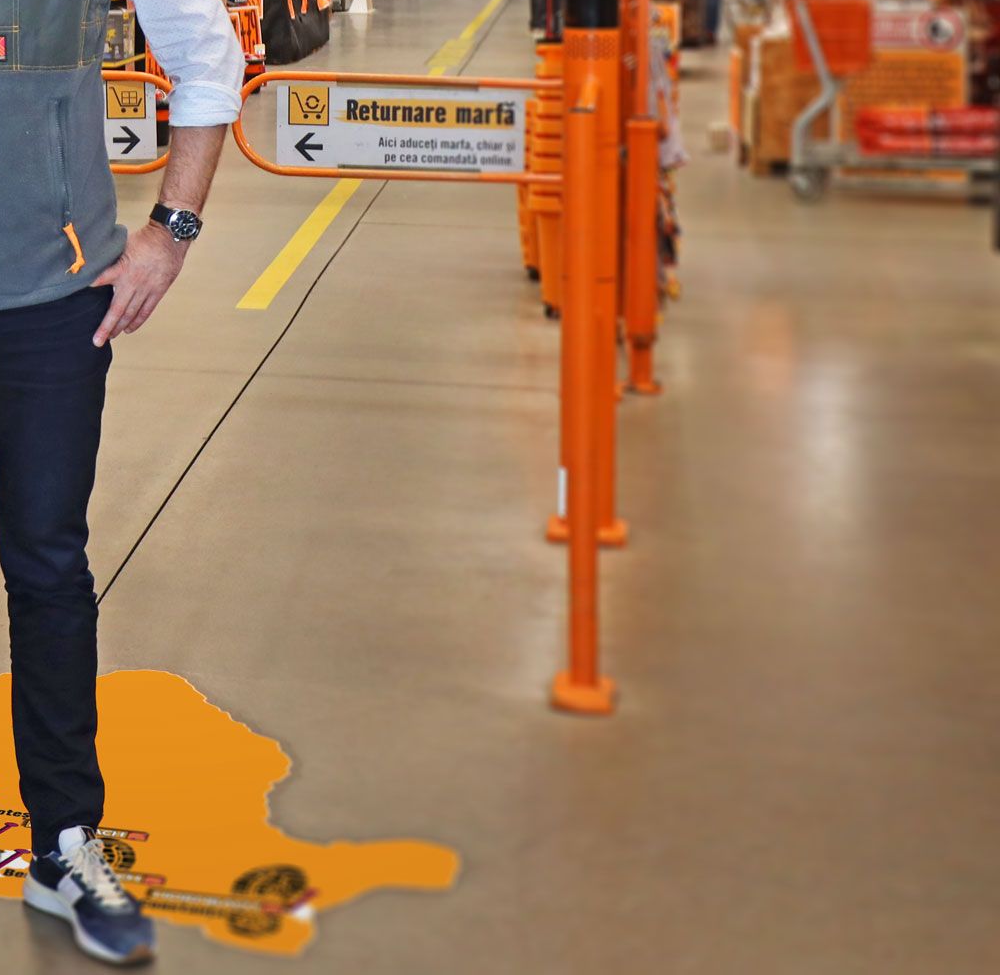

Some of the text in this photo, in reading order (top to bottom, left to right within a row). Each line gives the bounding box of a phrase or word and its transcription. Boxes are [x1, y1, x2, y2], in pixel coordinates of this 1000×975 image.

[346, 98, 516, 126] Returnare marfă
[378, 136, 398, 148] Aici
[400, 137, 438, 152] aduceți
[384, 153, 397, 165] pe
[400, 153, 418, 164] cea
[421, 152, 478, 166] comandată
